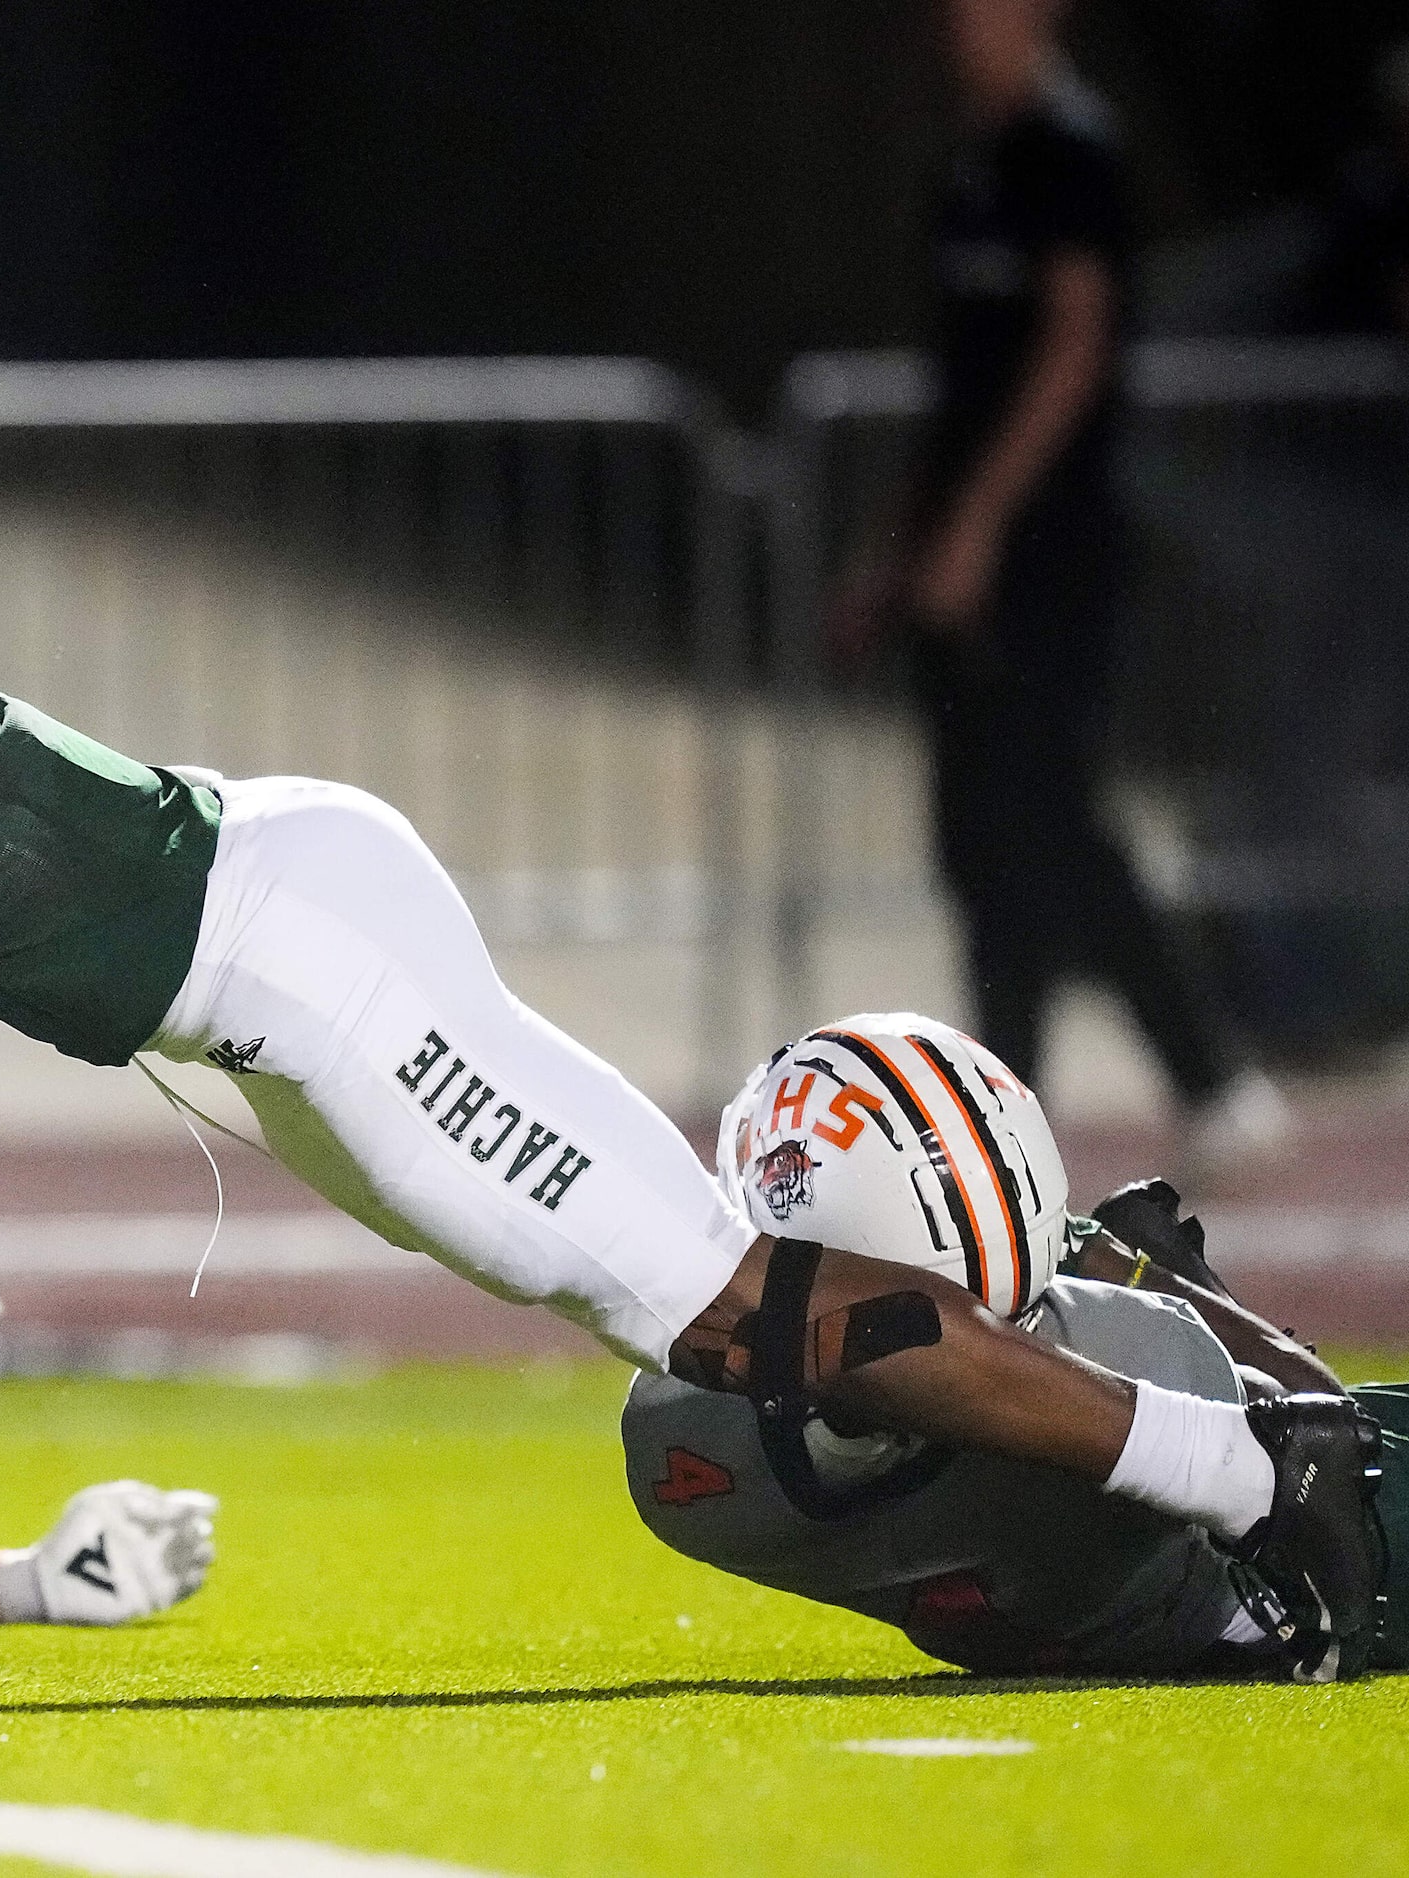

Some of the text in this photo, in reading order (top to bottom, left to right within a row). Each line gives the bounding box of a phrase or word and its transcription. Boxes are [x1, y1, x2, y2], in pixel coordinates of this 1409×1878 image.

[395, 1029, 591, 1212] HACHIE
[652, 1446, 735, 1507] 4
[1296, 1462, 1319, 1504] VAPOR
